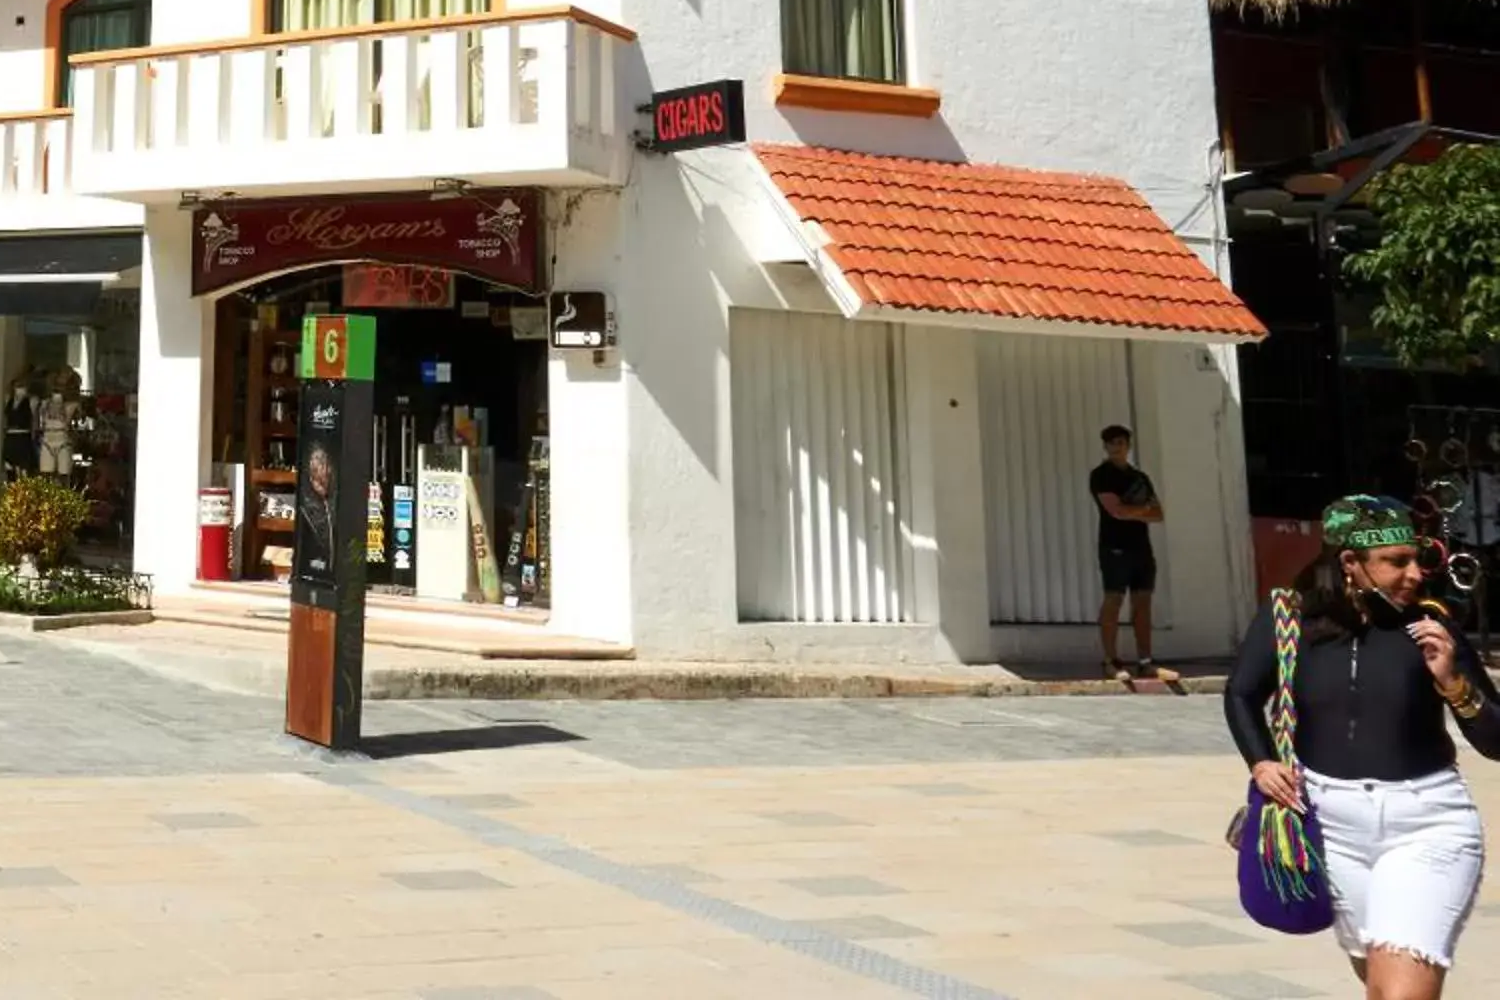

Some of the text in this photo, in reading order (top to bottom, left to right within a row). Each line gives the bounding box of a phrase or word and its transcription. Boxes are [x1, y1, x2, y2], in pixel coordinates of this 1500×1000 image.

[657, 91, 723, 141] CIGARS
[266, 206, 446, 249] Morgan's
[458, 239, 501, 249] TOBACCO
[476, 249, 500, 258] SHOP
[324, 329, 339, 364] 6
[507, 532, 522, 565] OCB
